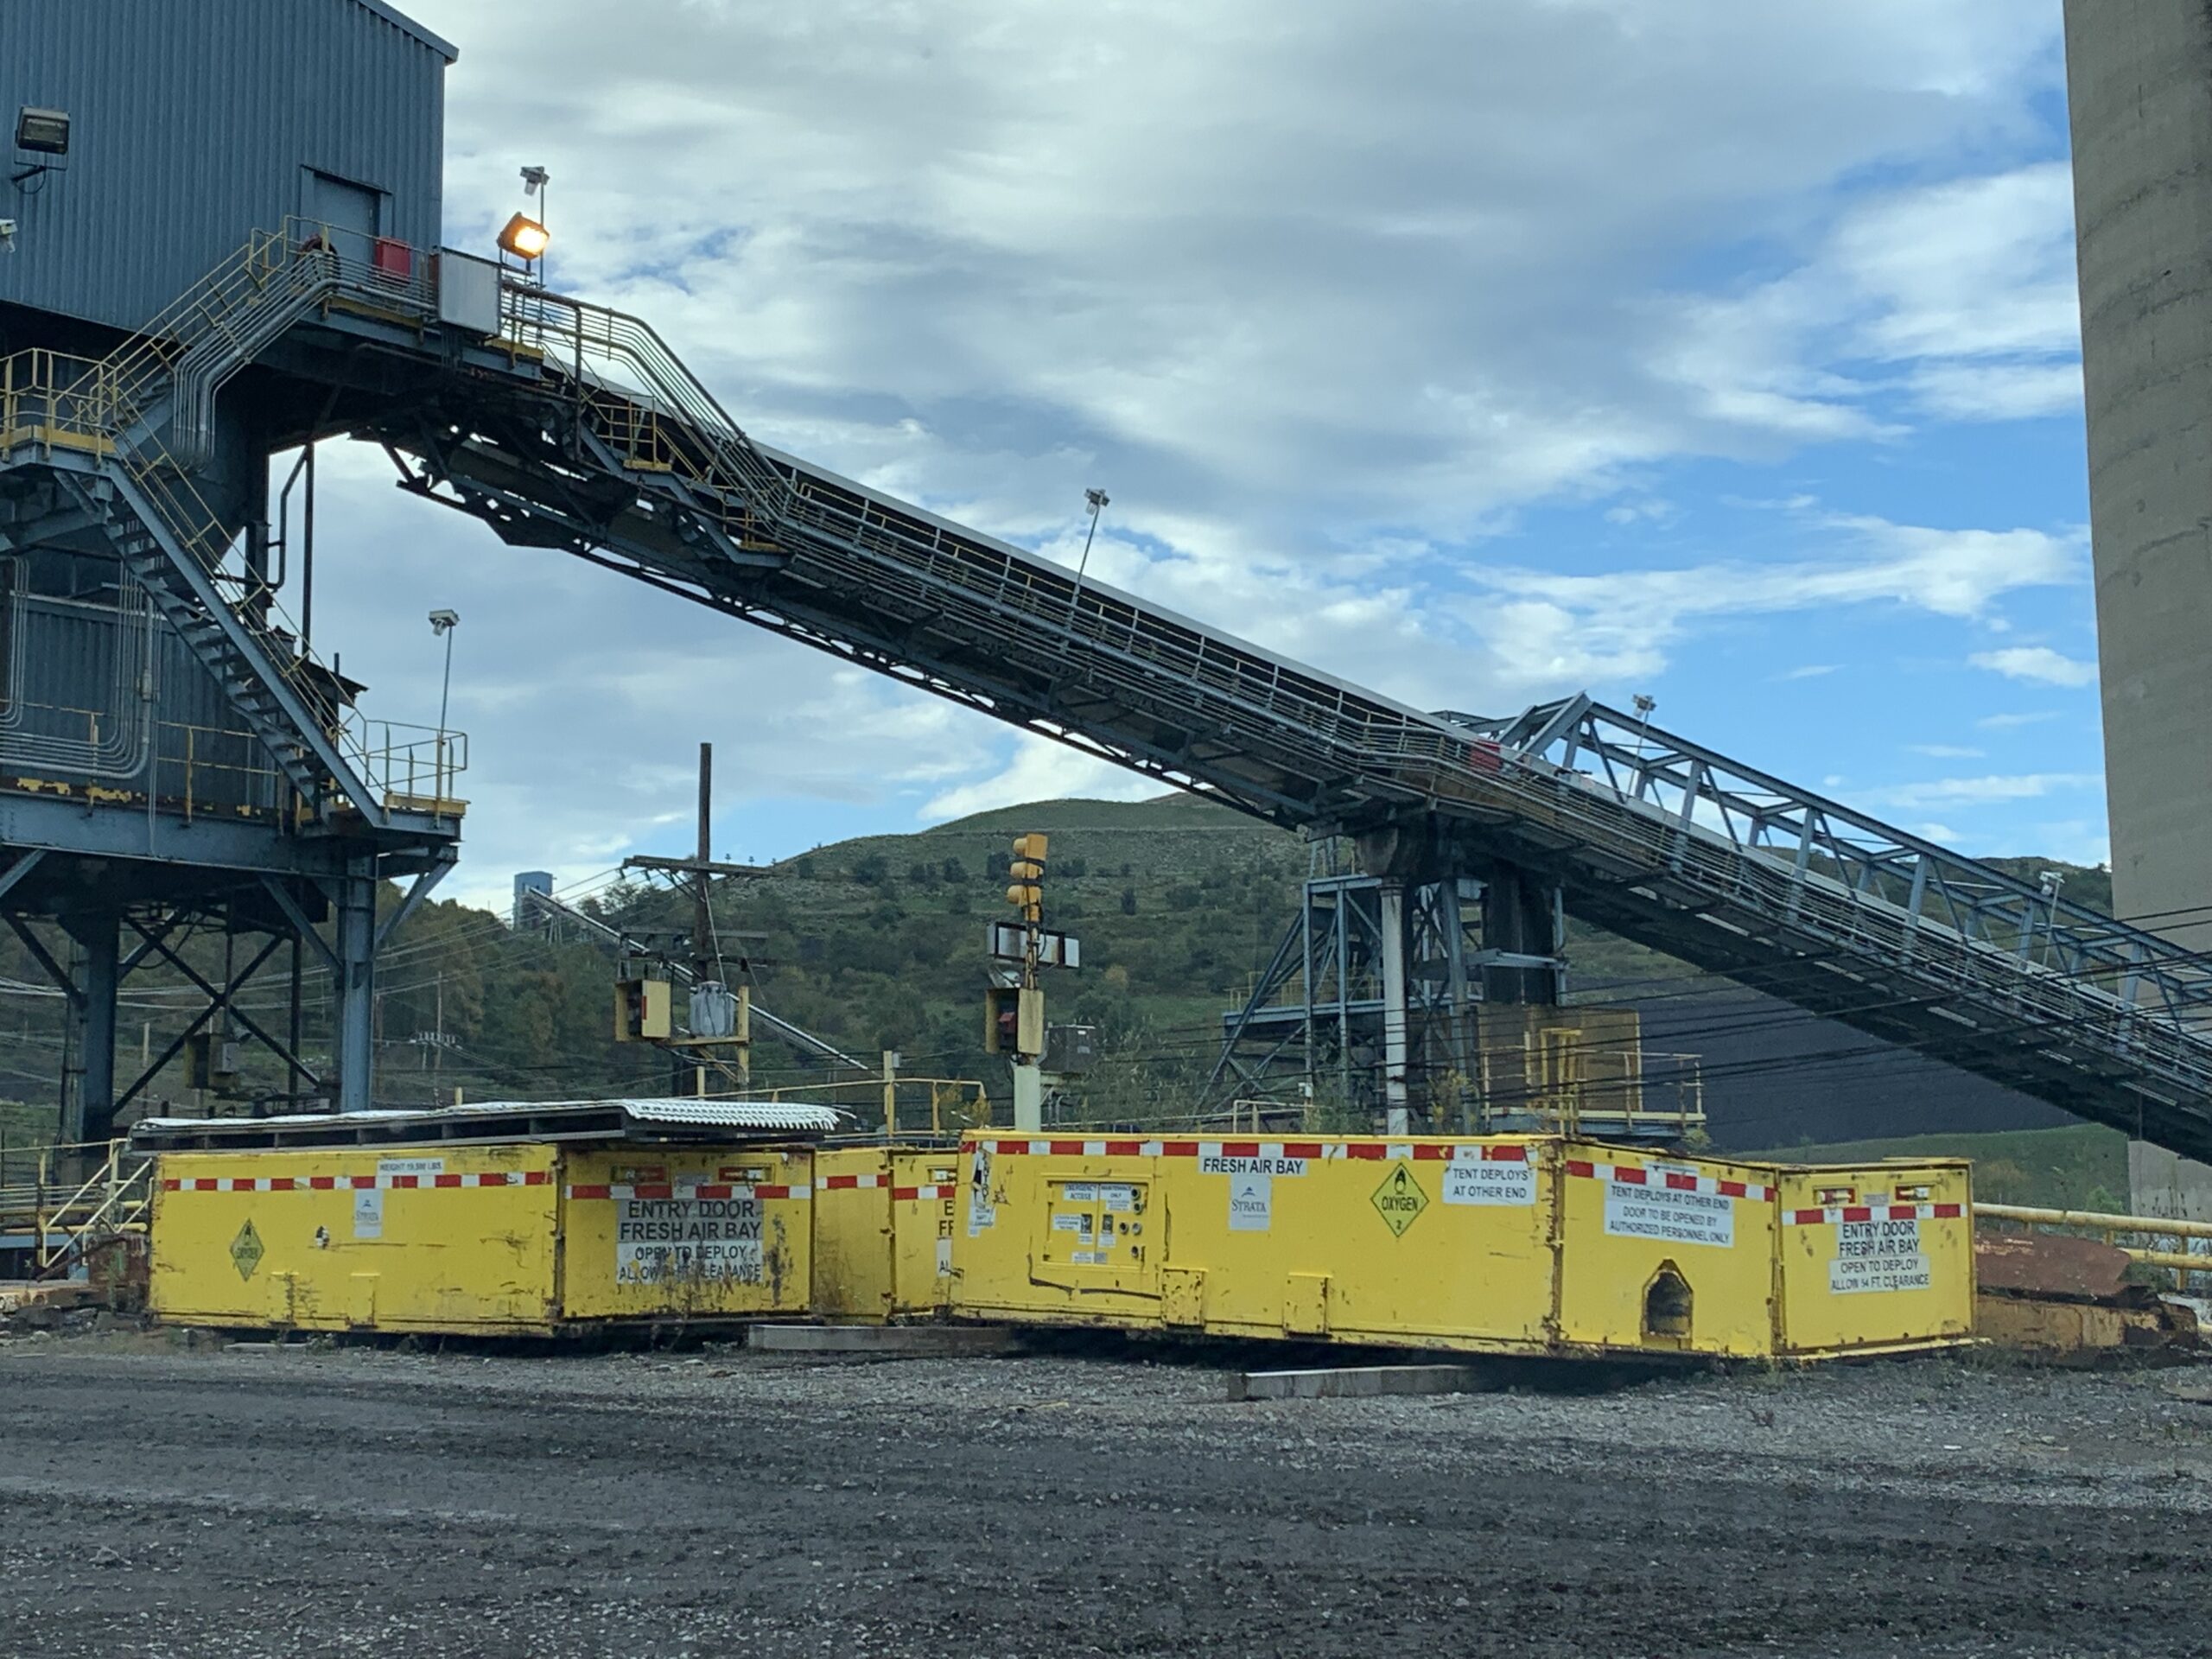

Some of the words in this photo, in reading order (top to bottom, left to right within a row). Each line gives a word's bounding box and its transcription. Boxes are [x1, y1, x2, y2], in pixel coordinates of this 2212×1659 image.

[1203, 1159, 1246, 1173] FRESH
[1249, 1160, 1272, 1173] AIR
[1276, 1160, 1303, 1174] BAY
[1453, 1168, 1478, 1179] TENT
[1481, 1168, 1529, 1181] DEPLOYS
[1453, 1185, 1466, 1197] AT
[1468, 1186, 1503, 1198] OTHER
[1506, 1187, 1528, 1198] END
[1611, 1185, 1633, 1198] TENT
[1634, 1188, 1671, 1203] DEPLOYS
[1672, 1193, 1682, 1203] AT
[1685, 1194, 1711, 1207] OTHER
[1713, 1198, 1730, 1210] END
[629, 1201, 691, 1218] ENTRY
[699, 1200, 754, 1217] DOOR
[1231, 1198, 1267, 1212] STRATA
[1382, 1197, 1418, 1211] OXYGEN
[1395, 1219, 1402, 1230] 2
[1623, 1206, 1646, 1217] DOOR
[1649, 1209, 1658, 1219] TO
[1660, 1211, 1671, 1222] BE
[1673, 1211, 1705, 1225] OPENED
[1707, 1216, 1717, 1227] BY
[620, 1223, 683, 1240] FRESH
[689, 1223, 719, 1239] AIR
[725, 1222, 761, 1239] BAY
[1610, 1221, 1659, 1235] AUTHORIZED
[1662, 1225, 1708, 1242] PERSONNEL
[1710, 1231, 1730, 1244] ONLY
[1843, 1223, 1880, 1238] ENTRY
[1884, 1221, 1915, 1236] DOOR
[635, 1246, 671, 1261] OPEN
[676, 1246, 692, 1260] TO
[696, 1245, 748, 1260] DEPLOY
[1840, 1242, 1875, 1256] FRESH
[1878, 1240, 1896, 1255] AIR
[1898, 1239, 1920, 1254] BAY
[1840, 1262, 1866, 1274] OPEN
[1869, 1261, 1880, 1271] TO
[1884, 1259, 1918, 1271] DEPLOY
[1832, 1279, 1859, 1291] ALLOW
[1884, 1274, 1929, 1287] CLEARANCE
